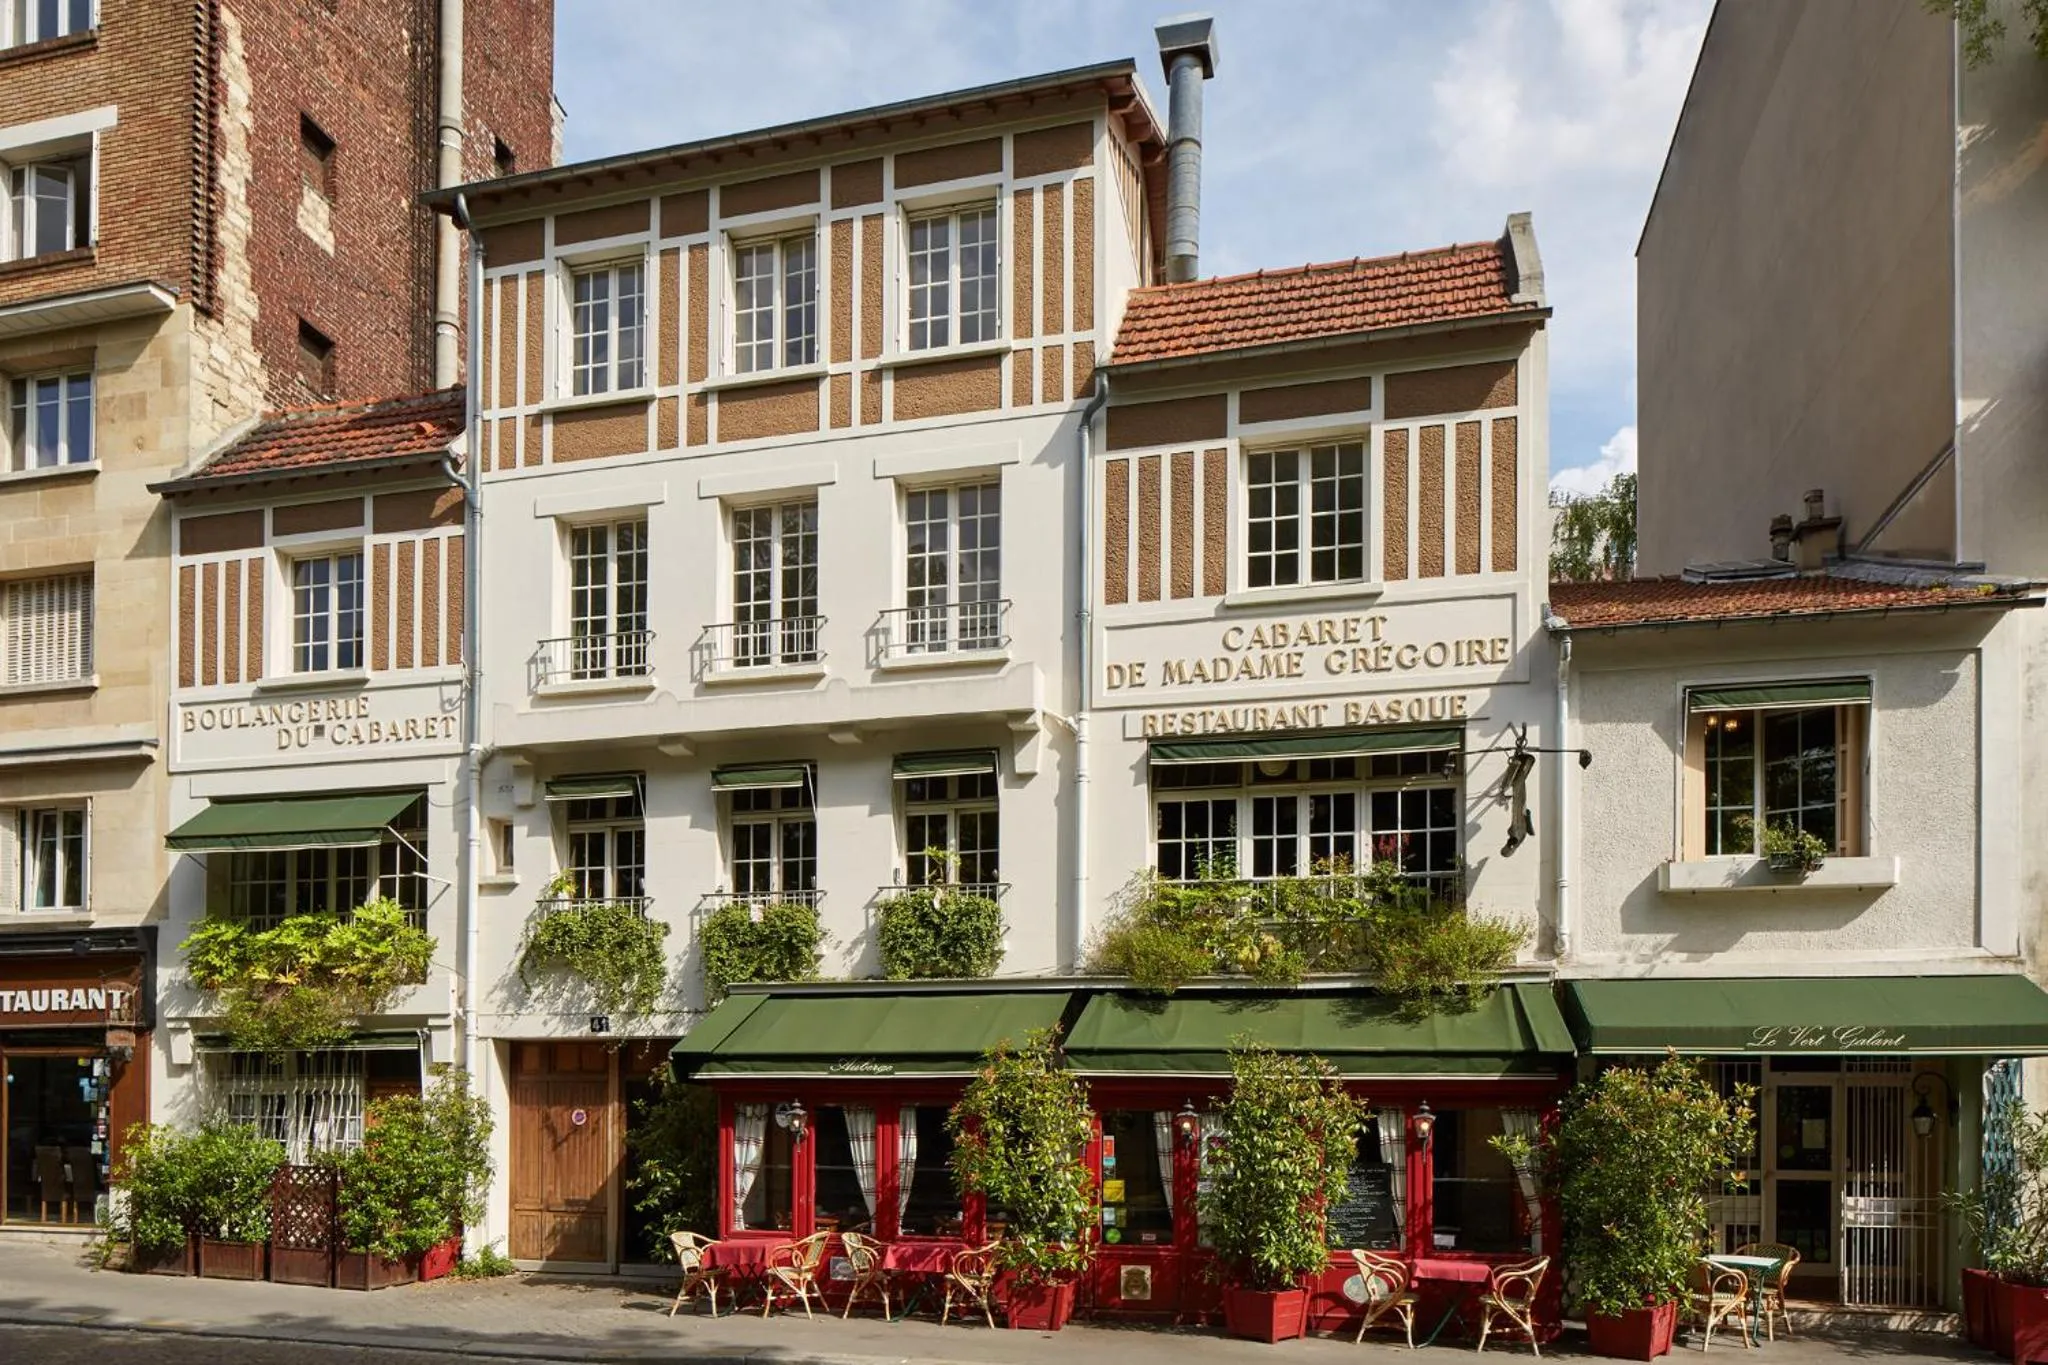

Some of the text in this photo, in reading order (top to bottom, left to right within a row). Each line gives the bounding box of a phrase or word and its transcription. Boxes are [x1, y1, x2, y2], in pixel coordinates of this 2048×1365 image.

[1222, 616, 1387, 651] CABARET
[1106, 637, 1510, 690] DE MADAME GRÉGOIRE
[183, 697, 370, 732] BOULANGERIE
[1142, 695, 1468, 737] RESTAURANT BASQUE
[277, 715, 456, 750] DU CABARET
[1746, 1024, 1906, 1050] Le Vert Galant
[829, 1057, 894, 1075] Auberge
